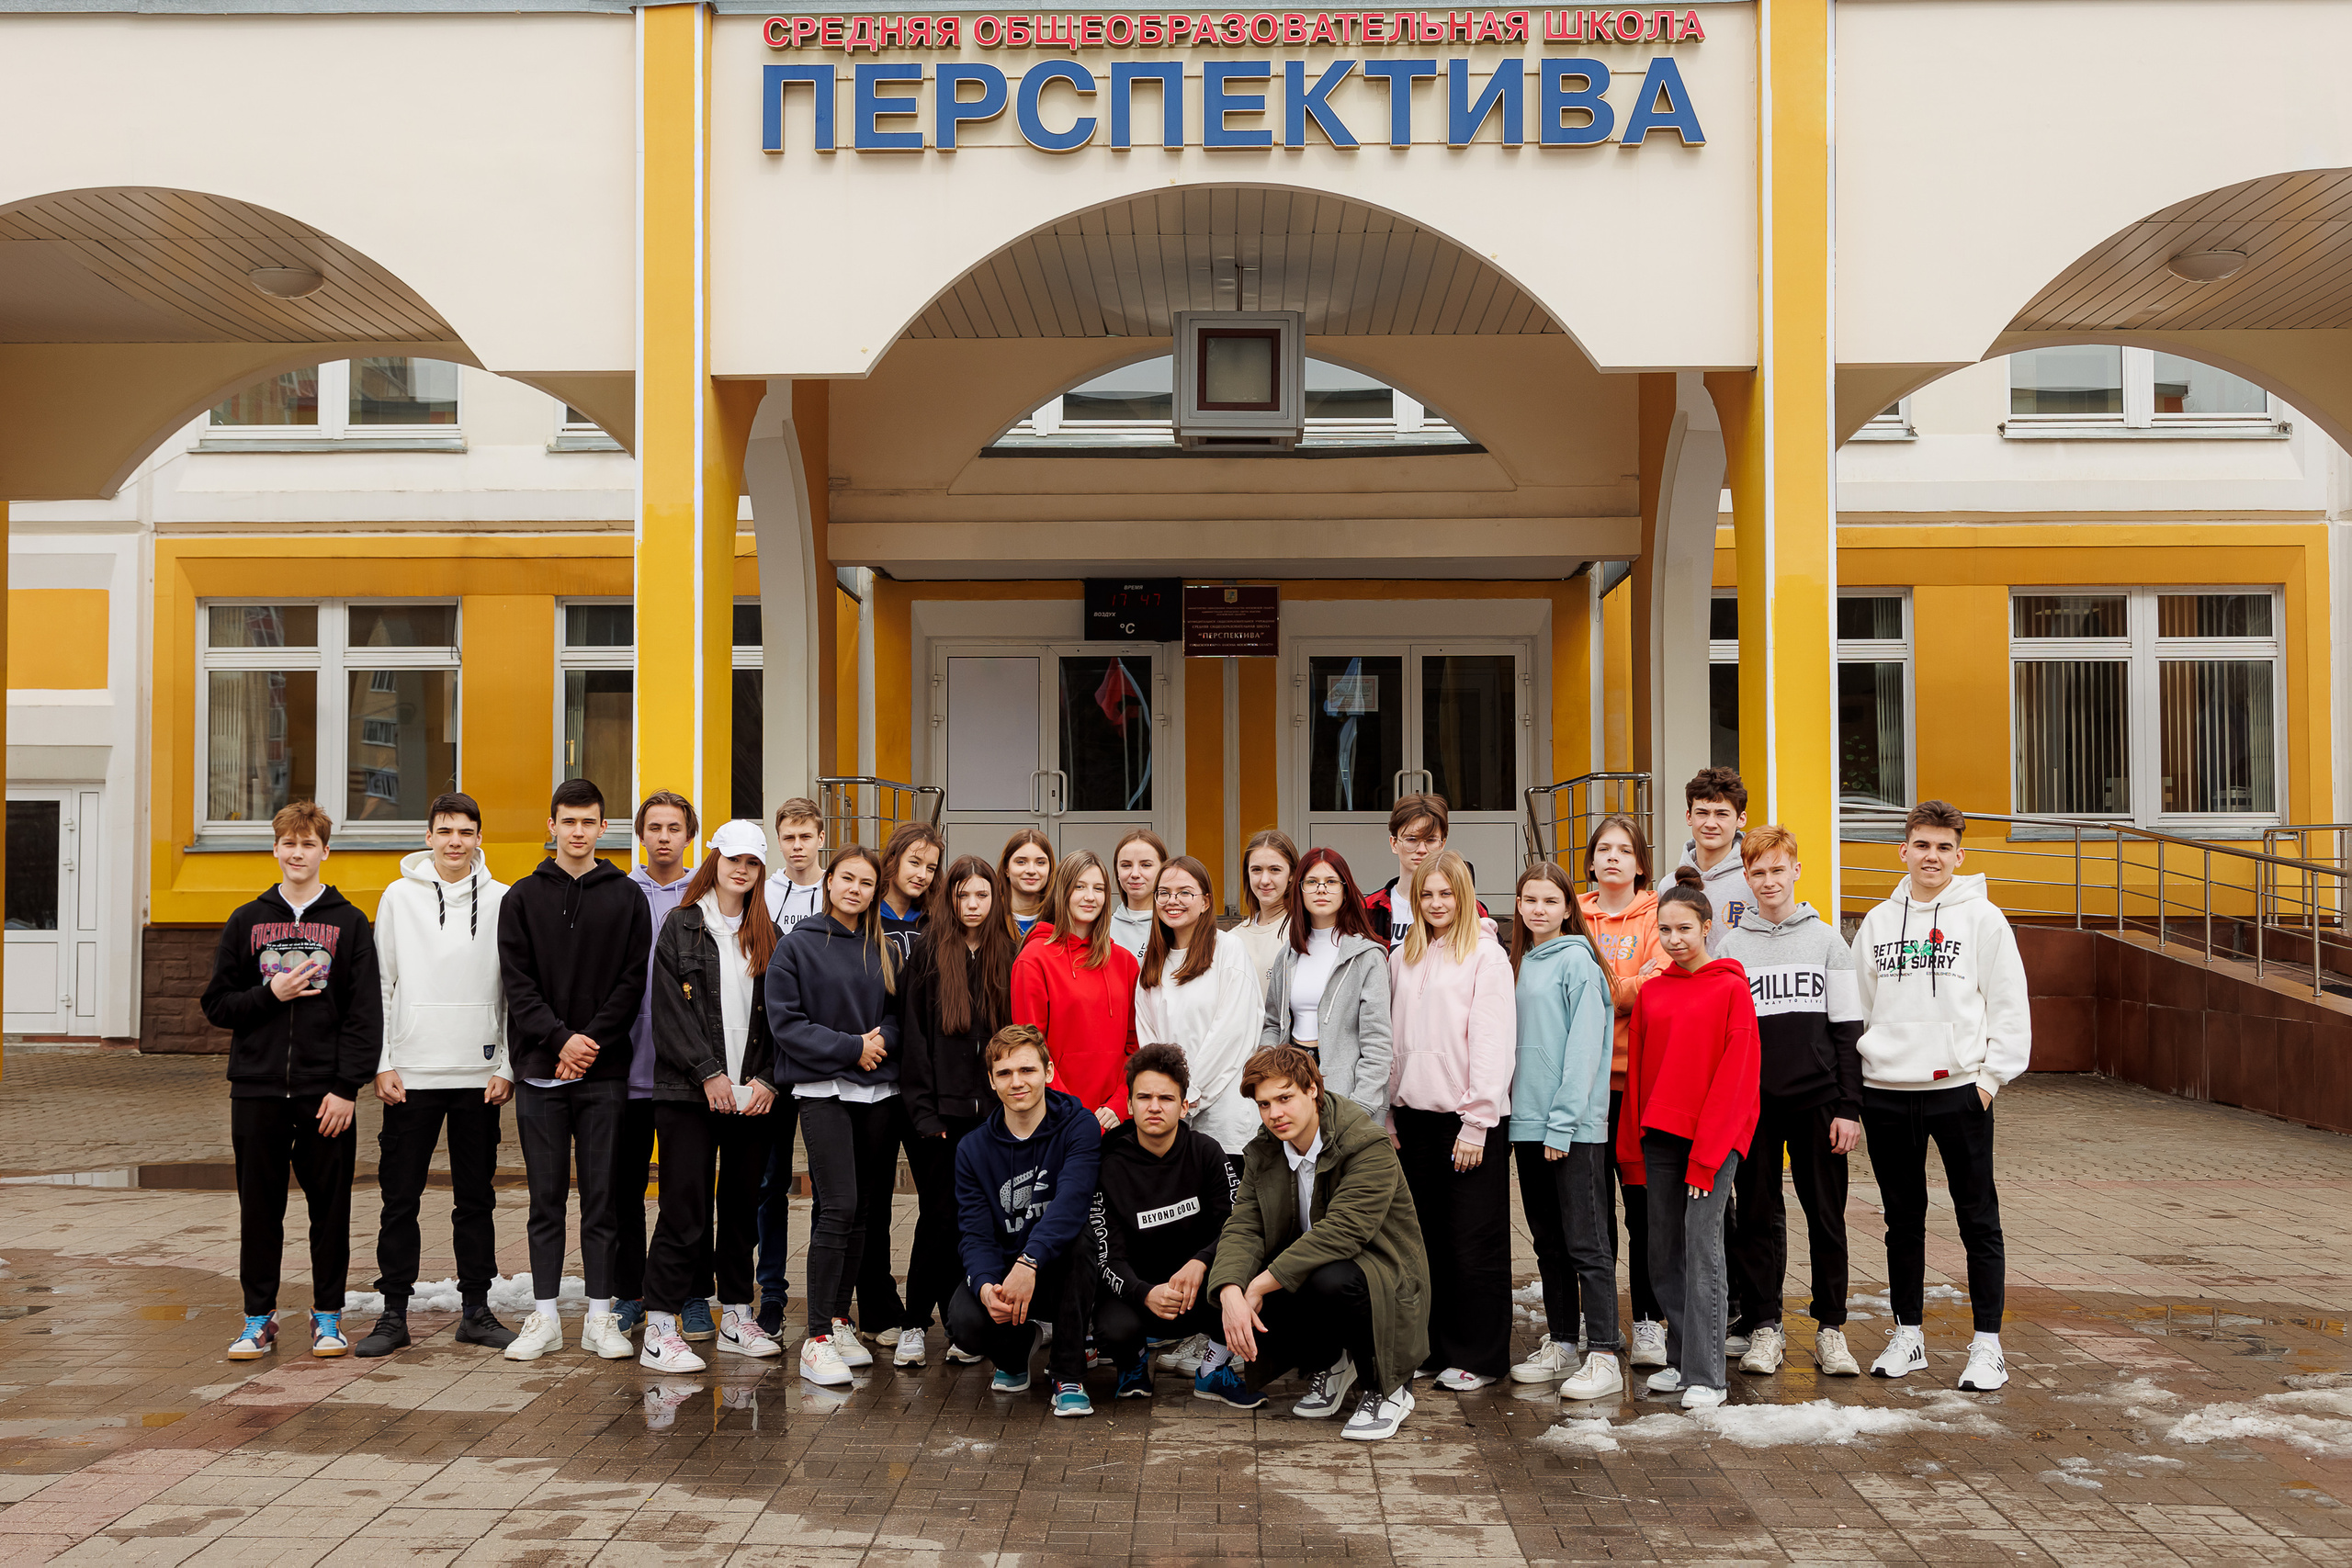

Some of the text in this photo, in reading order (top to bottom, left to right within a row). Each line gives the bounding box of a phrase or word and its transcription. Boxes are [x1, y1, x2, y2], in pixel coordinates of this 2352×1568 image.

[763, 10, 1707, 53] СРЕДНЯЯ ОБЩЕОБРАЗОВАТЕЛЬНАЯ ШКОЛА
[762, 56, 1708, 154] ПЕРСПЕКТИВА
[1142, 1201, 1196, 1224] BEYOND COOL
